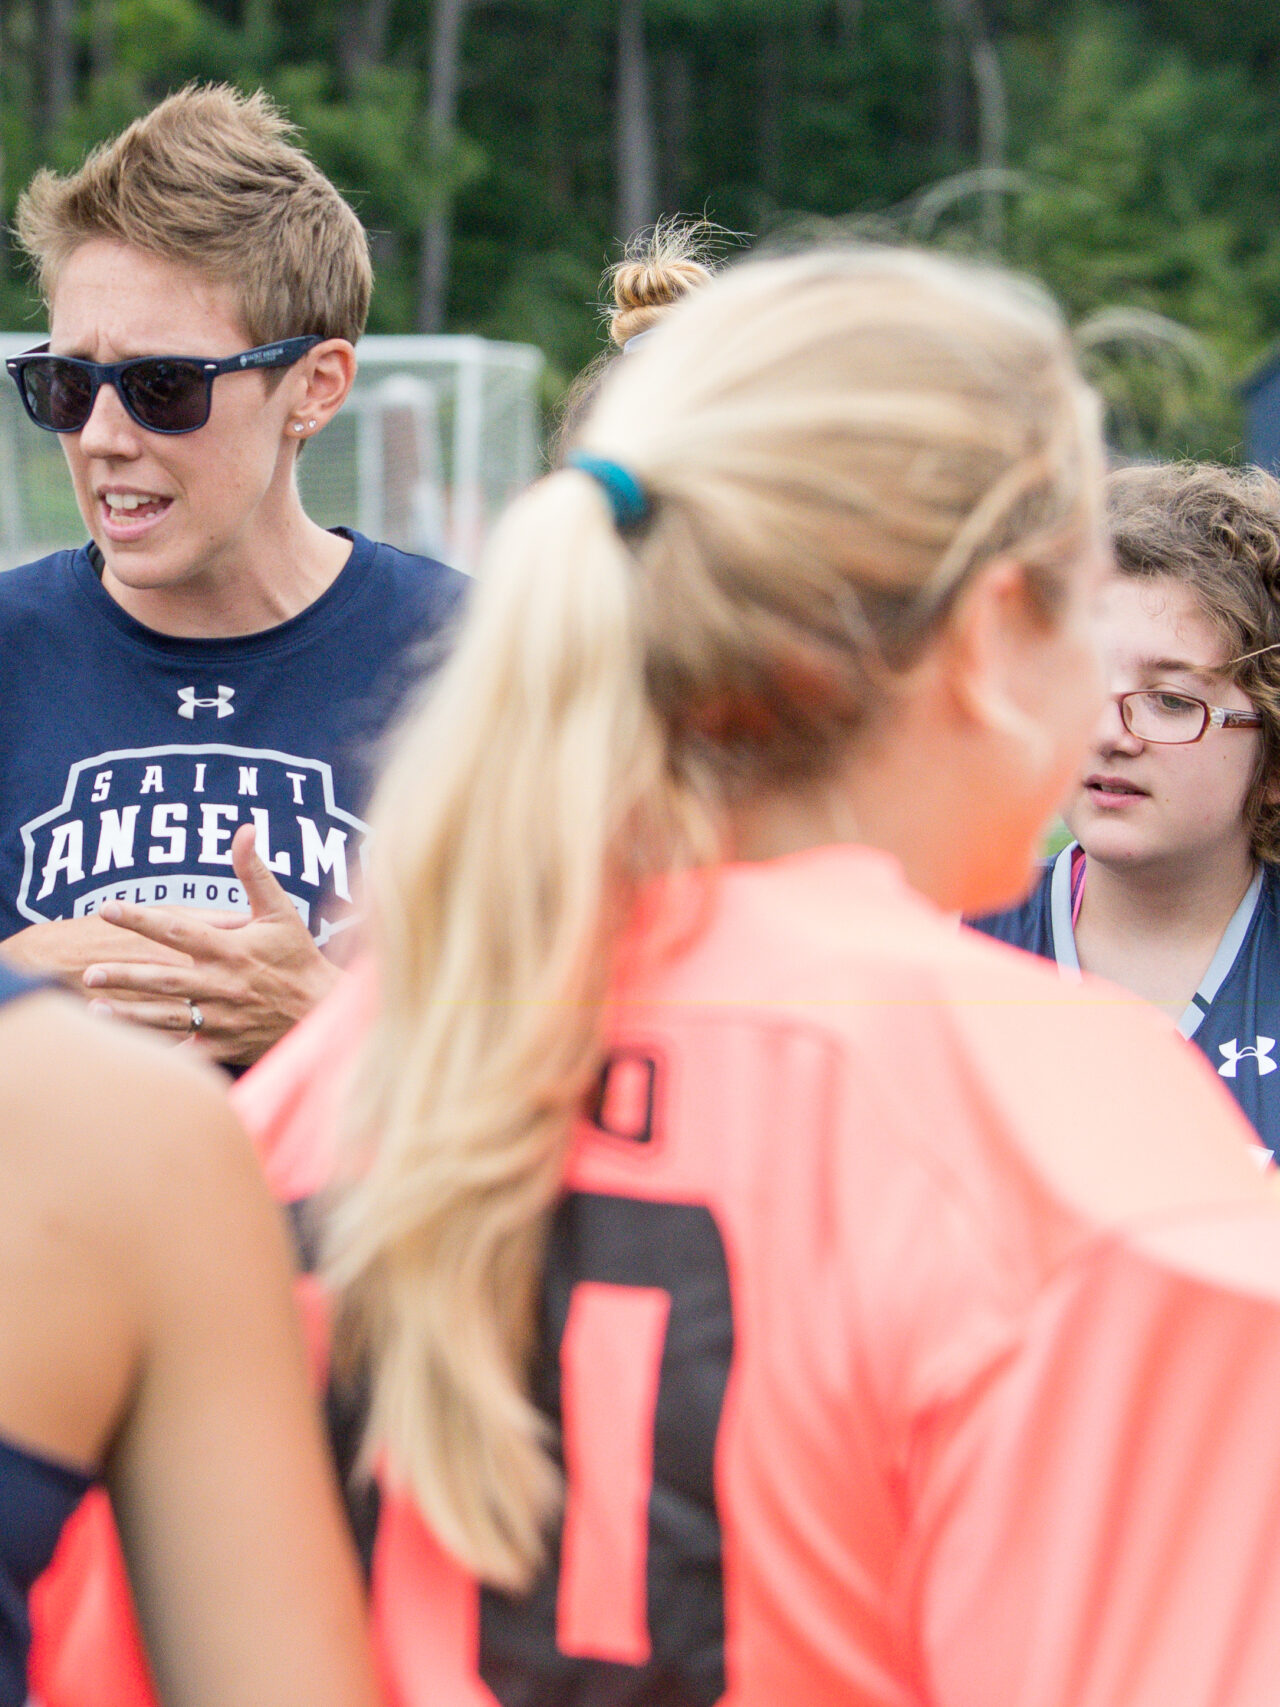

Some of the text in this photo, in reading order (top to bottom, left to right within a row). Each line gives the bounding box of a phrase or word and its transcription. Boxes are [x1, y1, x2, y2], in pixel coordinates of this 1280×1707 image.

[91, 762, 307, 806] SAINT
[35, 802, 354, 904] ANSELM
[84, 884, 168, 917] FELD
